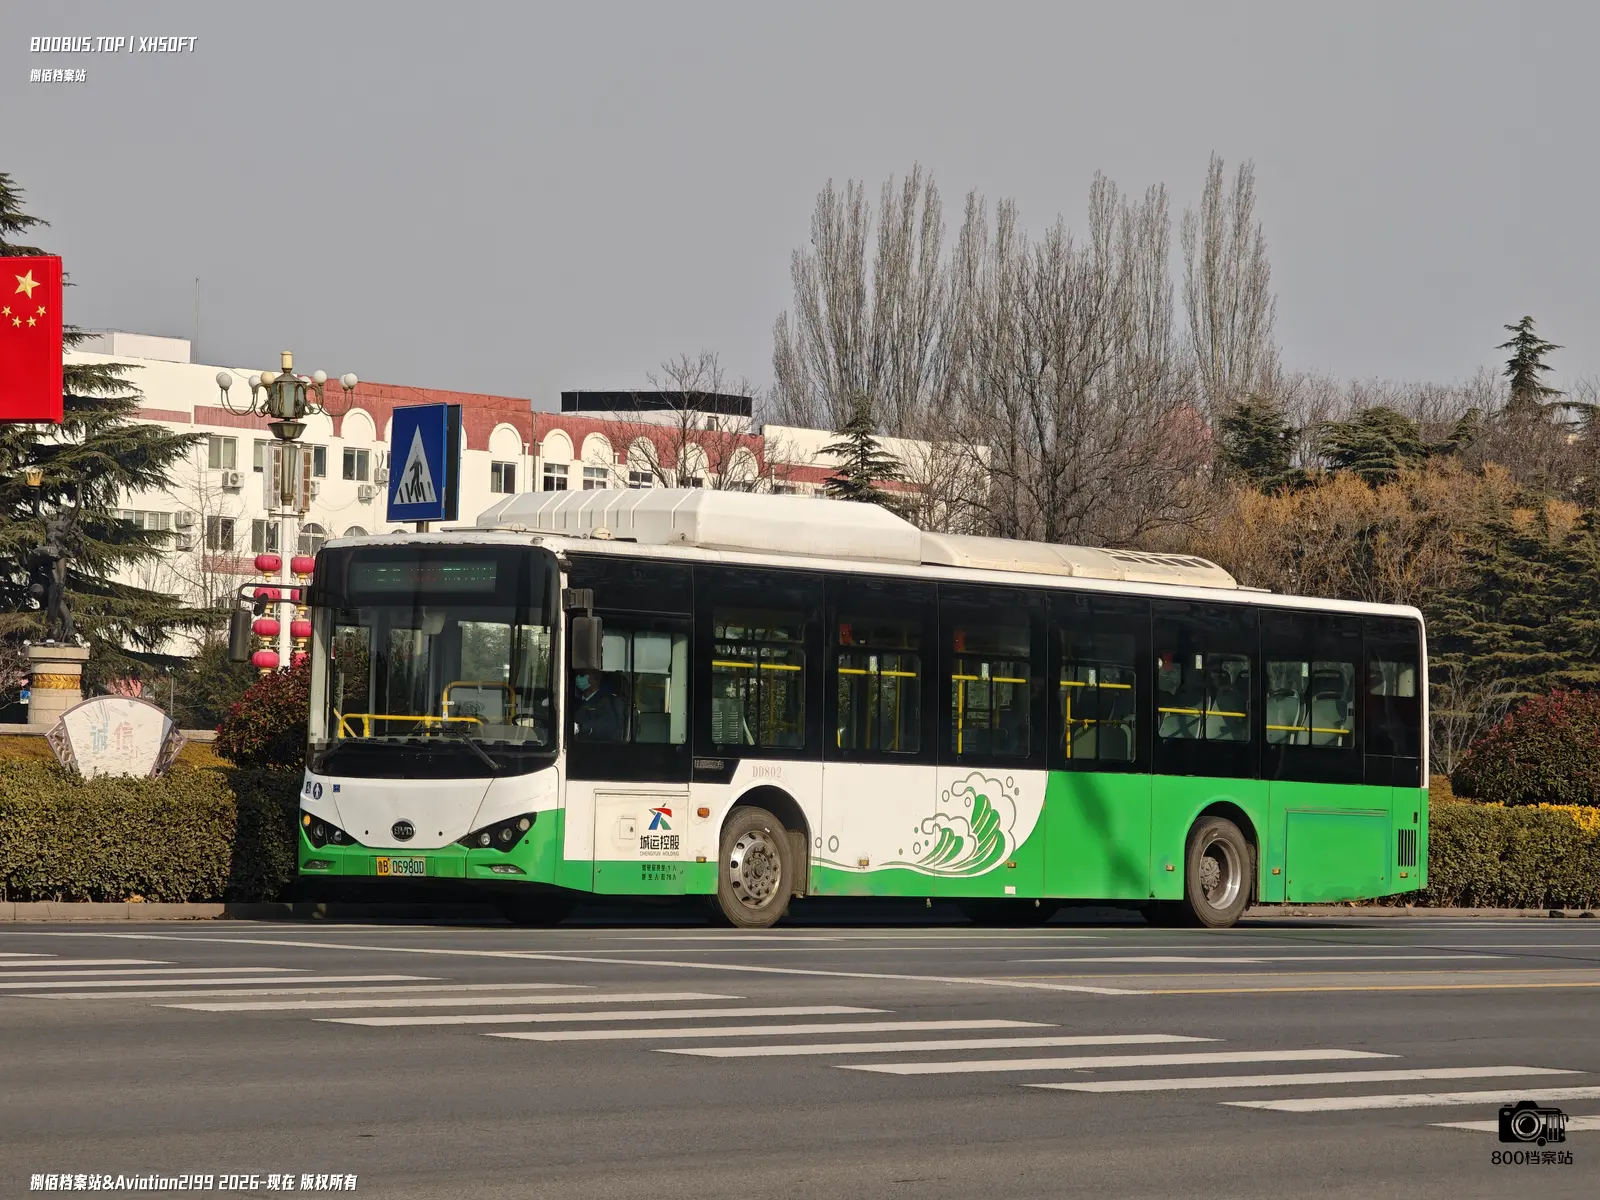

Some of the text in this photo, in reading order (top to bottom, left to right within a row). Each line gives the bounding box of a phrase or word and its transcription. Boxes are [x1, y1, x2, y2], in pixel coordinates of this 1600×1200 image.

[752, 765, 782, 778] DD802
[394, 826, 413, 836] BYD
[640, 834, 680, 850] 城运控股
